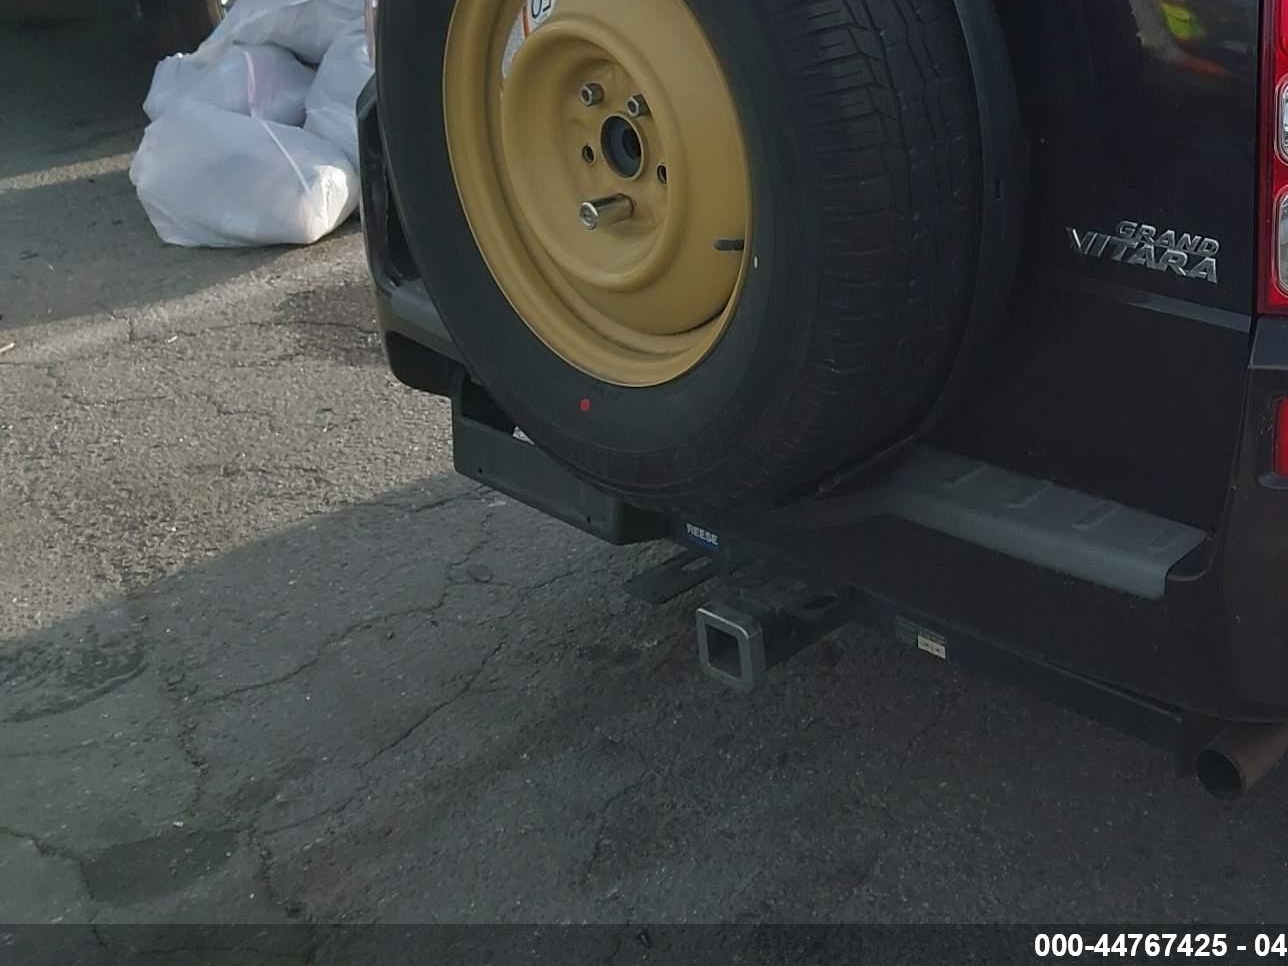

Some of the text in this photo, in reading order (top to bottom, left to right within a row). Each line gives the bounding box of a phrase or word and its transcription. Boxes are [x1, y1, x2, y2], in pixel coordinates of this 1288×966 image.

[1066, 227, 1218, 284] VITARA
[1118, 220, 1220, 256] GRAND
[686, 523, 719, 546] REESE
